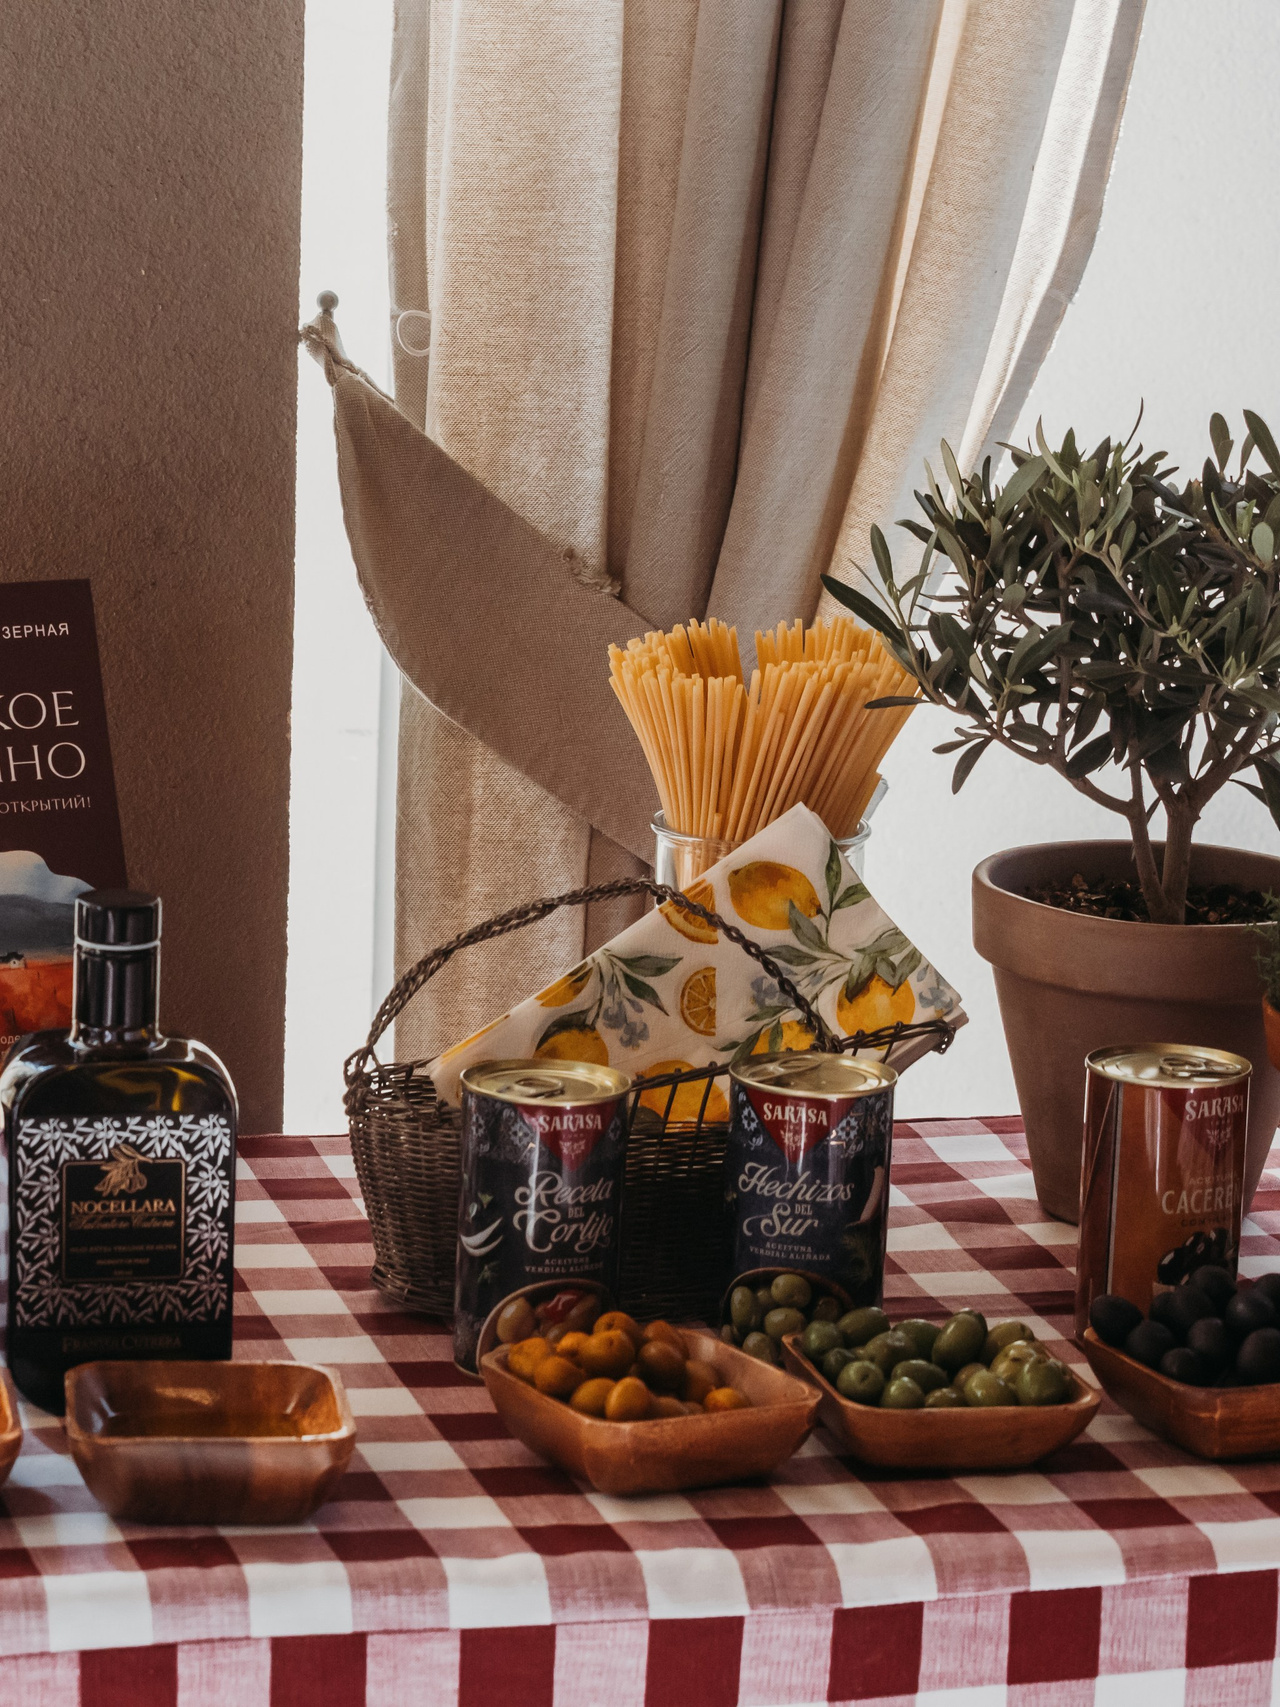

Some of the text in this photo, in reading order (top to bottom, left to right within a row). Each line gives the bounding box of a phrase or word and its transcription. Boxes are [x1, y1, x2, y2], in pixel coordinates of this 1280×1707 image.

[763, 1102, 829, 1127] SARASA
[1185, 1094, 1245, 1122] SARASA
[537, 1113, 603, 1134] SARASA
[514, 1170, 614, 1207] Receta
[738, 1161, 855, 1203] Hechizos
[70, 1198, 177, 1215] NOCELLARA
[567, 1206, 585, 1219] DEL
[794, 1203, 813, 1216] DEL
[742, 1202, 819, 1237] Sur
[749, 1246, 787, 1260] VERDIAL
[765, 1241, 813, 1254] ACEITUNA
